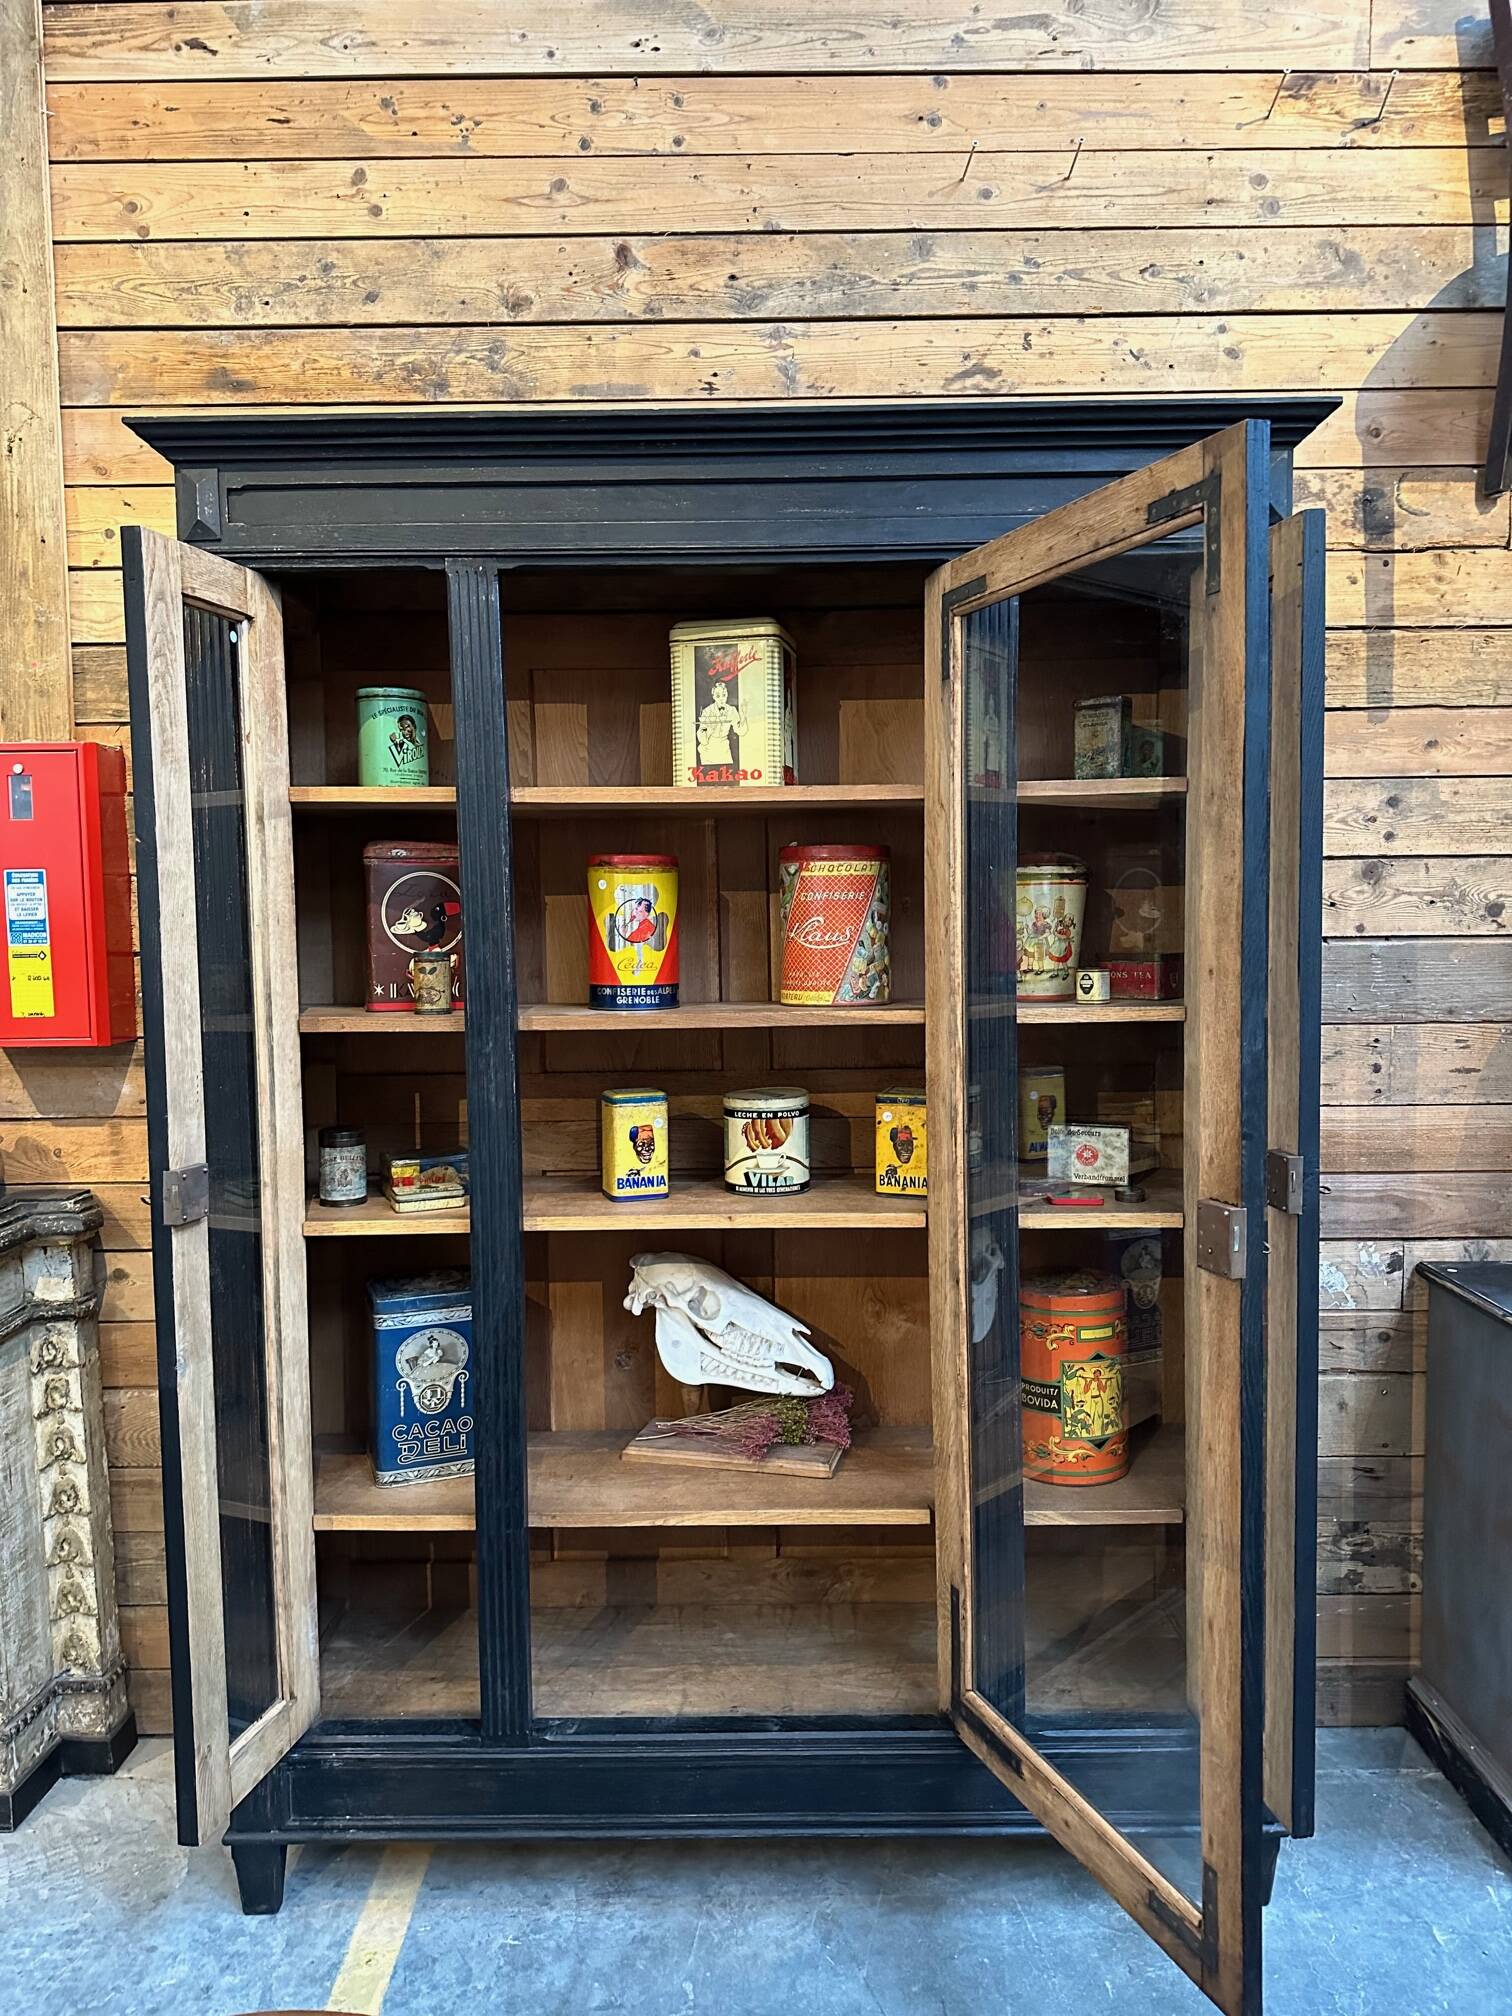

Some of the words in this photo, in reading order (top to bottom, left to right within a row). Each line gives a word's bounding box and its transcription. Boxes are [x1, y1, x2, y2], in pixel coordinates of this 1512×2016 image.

[687, 764, 763, 783] Kakao
[810, 863, 874, 873] CHOCOLAT
[800, 891, 866, 901] CONFISERIE
[597, 987, 647, 996] CONFISERIE
[616, 995, 660, 1005] GRENOBLE
[734, 1111, 758, 1119] LECHE
[777, 1110, 800, 1118] POLVO
[616, 1174, 667, 1190] BANANIA
[744, 1171, 795, 1187] VILAR
[879, 1173, 928, 1189] BANANIA
[1021, 1392, 1059, 1410] BOVIDA
[392, 1415, 474, 1442] CACAO
